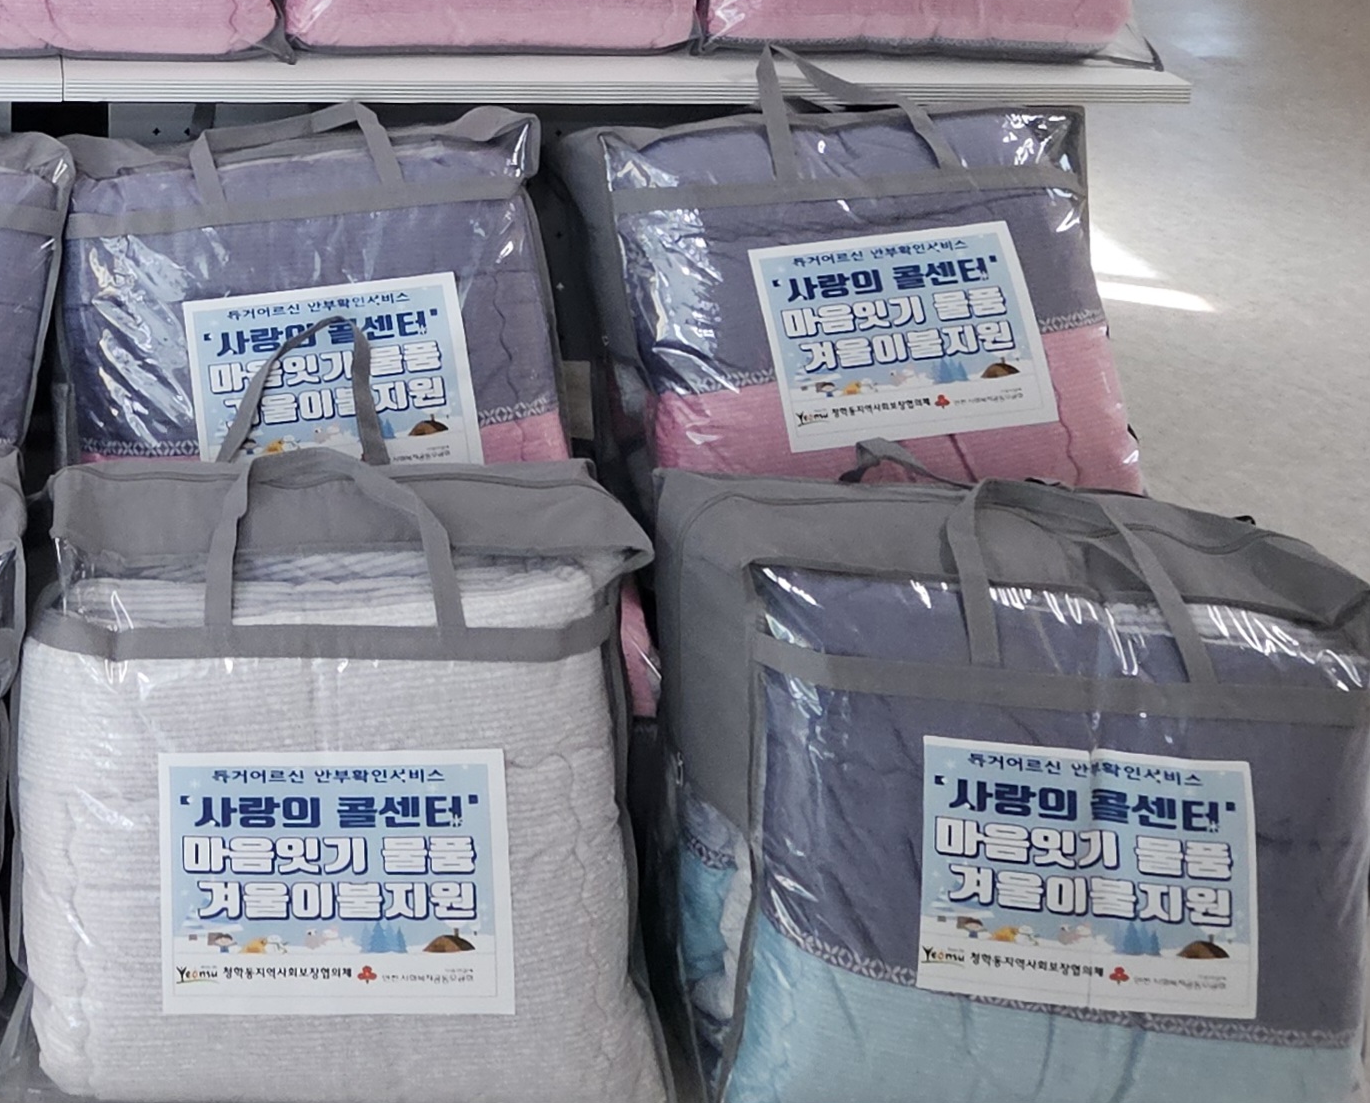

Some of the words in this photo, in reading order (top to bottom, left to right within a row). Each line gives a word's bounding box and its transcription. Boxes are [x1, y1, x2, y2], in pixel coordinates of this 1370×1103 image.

[782, 295, 926, 338] 마음잇기
[933, 286, 1007, 321] 물품
[369, 341, 442, 377] 물품
[800, 320, 1015, 372] 겨울이불지원
[212, 770, 305, 783] 독거어르신
[968, 753, 1061, 775] 독거어르신
[182, 836, 368, 875] 마음잇기
[382, 836, 477, 874] 물품
[934, 816, 1120, 870] 마음잇기
[1135, 835, 1233, 881] 물품
[198, 881, 477, 920] 겨울이불지원
[948, 864, 1232, 927] 겨울이불지원
